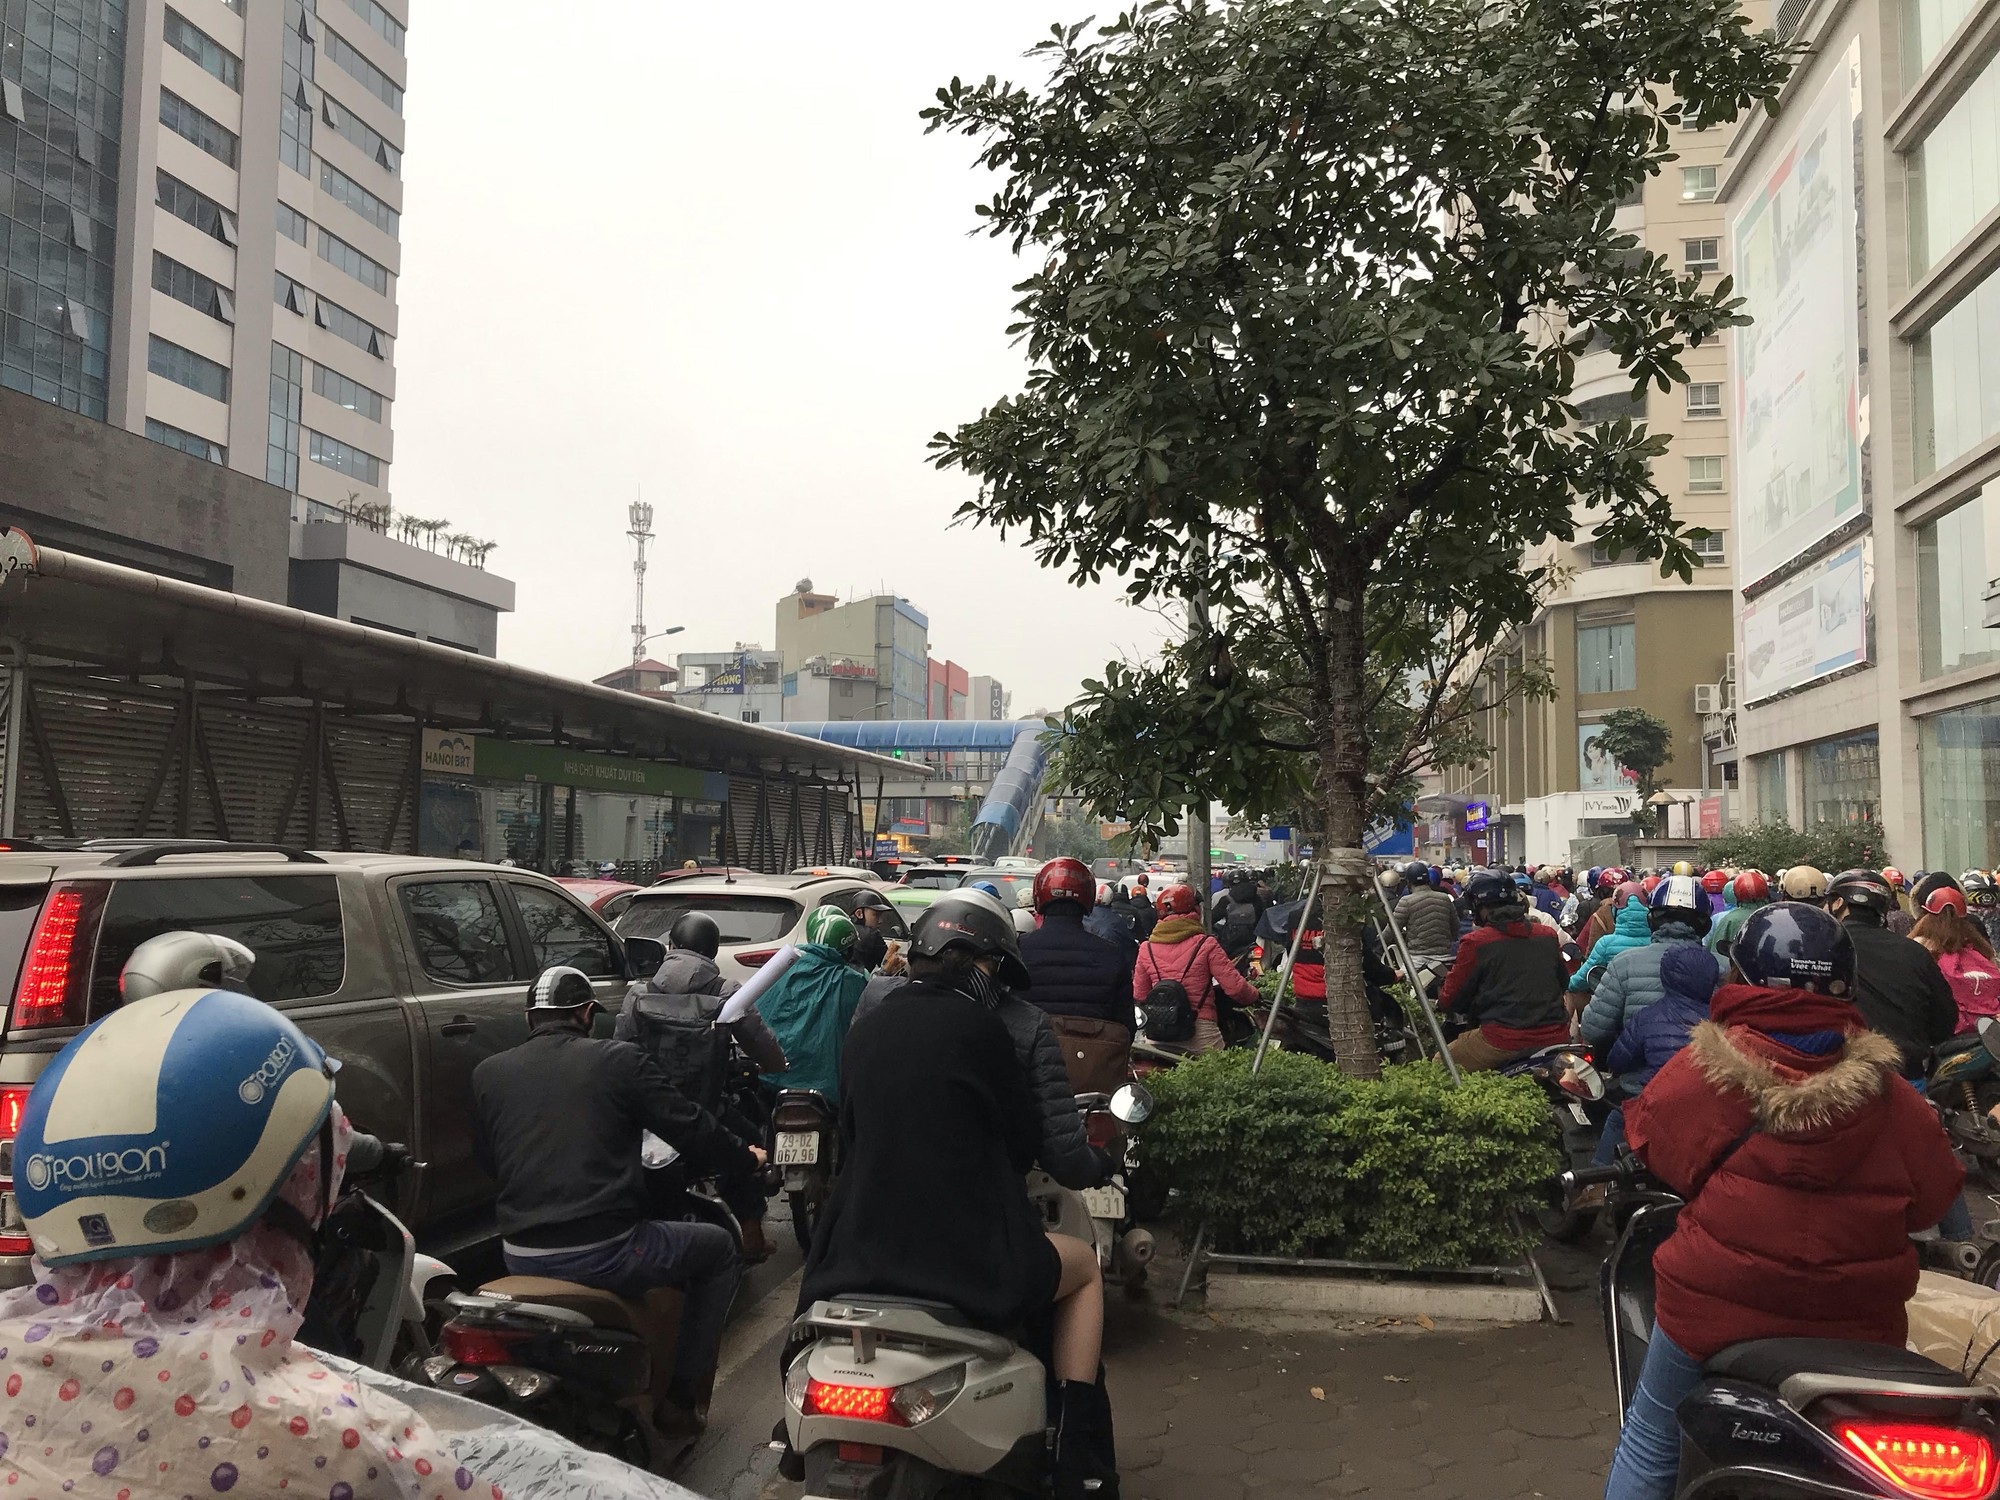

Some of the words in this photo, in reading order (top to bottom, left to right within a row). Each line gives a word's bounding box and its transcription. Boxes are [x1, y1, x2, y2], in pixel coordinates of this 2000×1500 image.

[0, 556, 34, 575] ,2m
[425, 752, 454, 766] HANOI
[455, 756, 471, 768] BRT
[618, 768, 632, 781] DUY
[1585, 801, 1603, 811] IVY
[782, 1134, 812, 1148] 29-D2
[777, 1148, 814, 1162] 067.96
[478, 1290, 513, 1300] HONDA
[833, 1369, 874, 1379] HONDA
